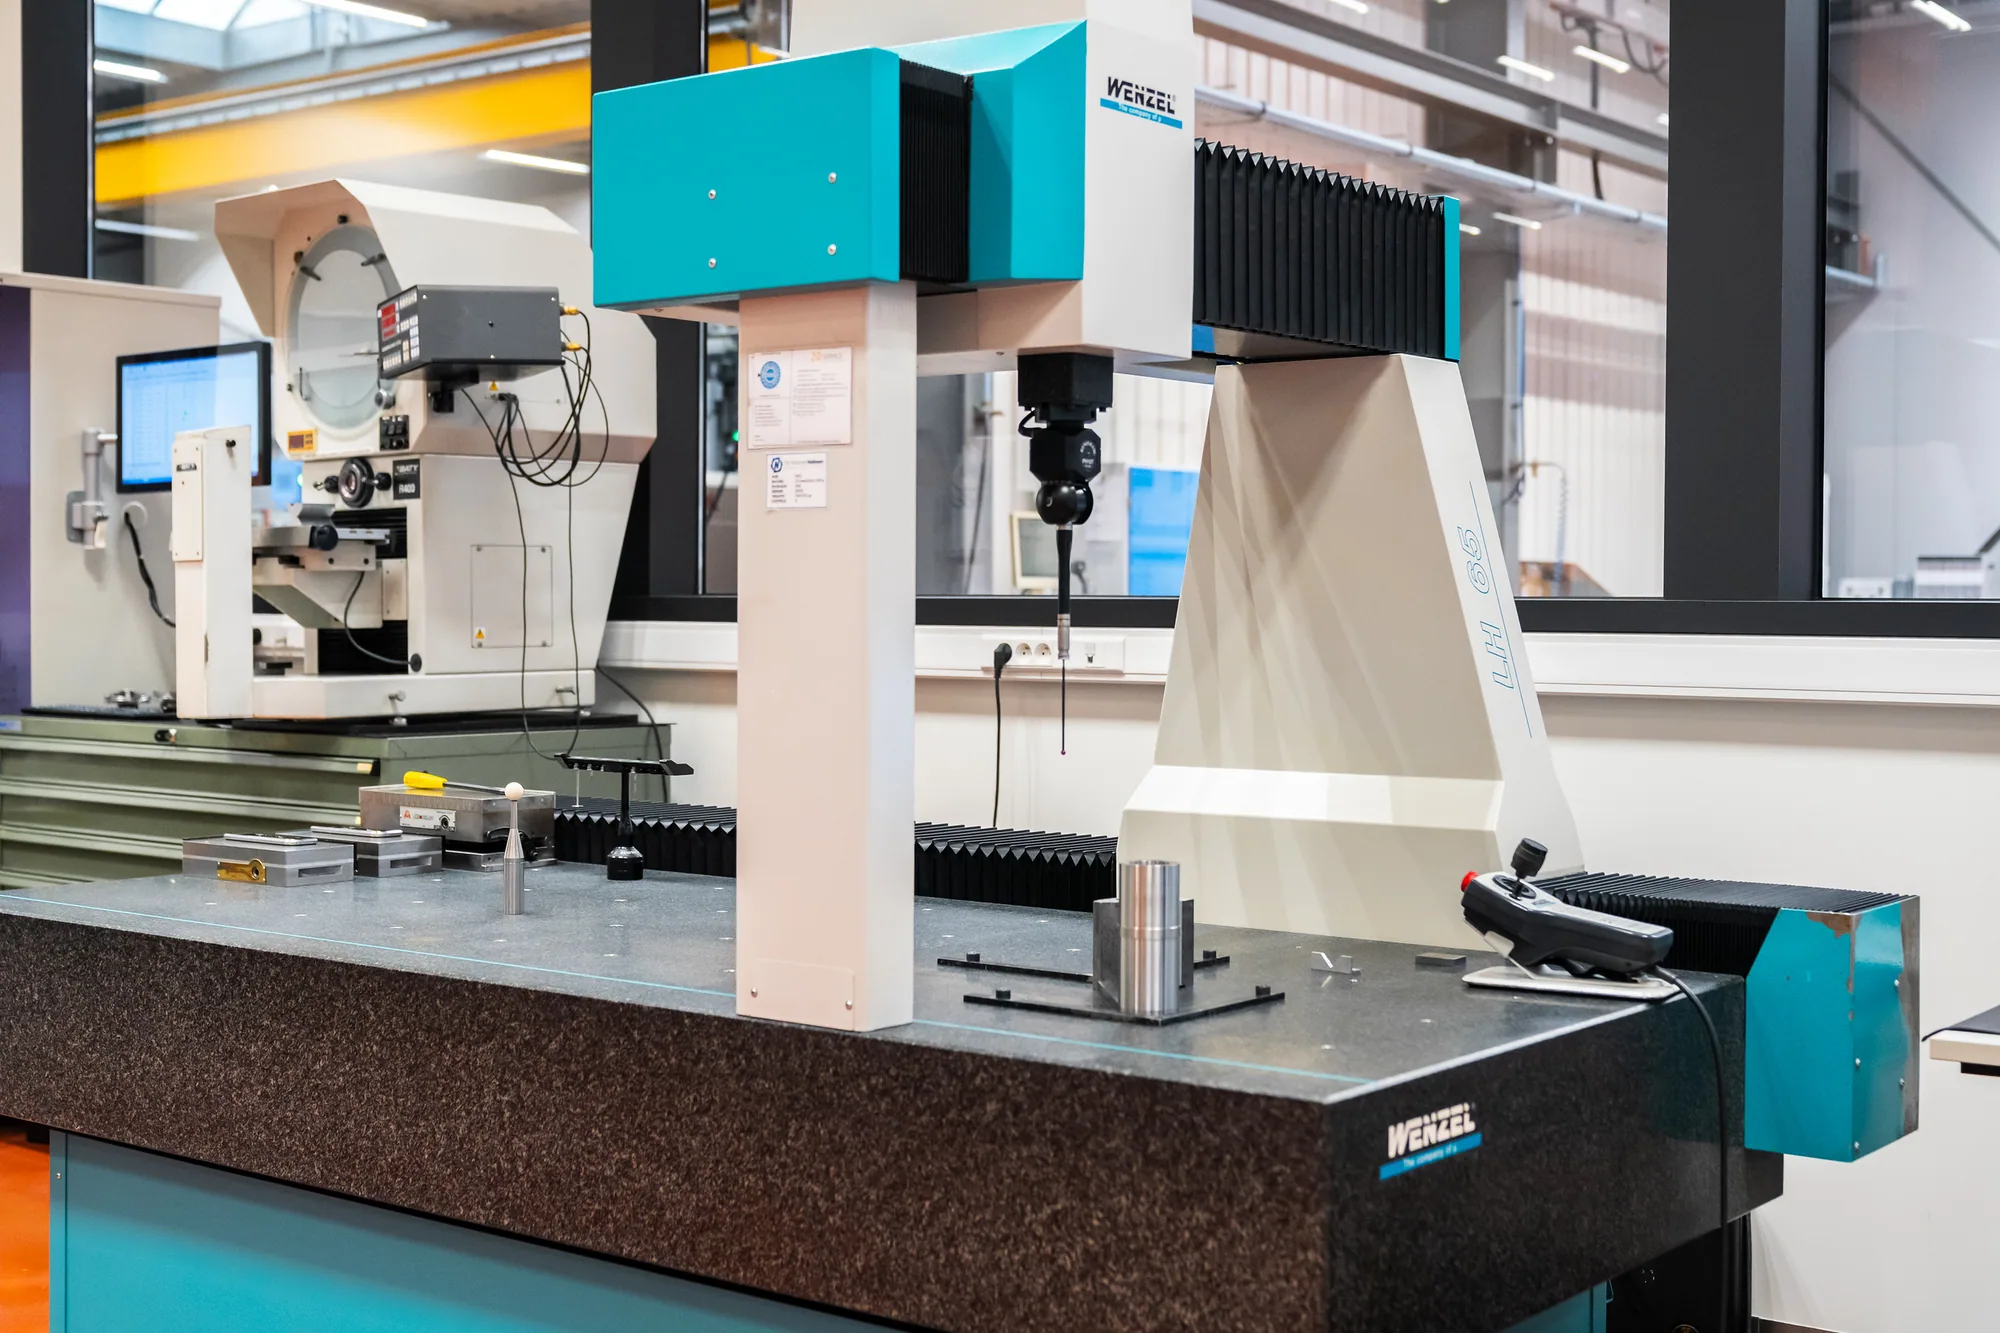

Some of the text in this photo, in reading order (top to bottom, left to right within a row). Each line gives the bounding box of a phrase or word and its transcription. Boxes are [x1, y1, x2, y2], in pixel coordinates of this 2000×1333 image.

[1107, 76, 1175, 115] WENZEL
[1456, 525, 1515, 690] LH 65
[1387, 1101, 1476, 1159] WENZEL
